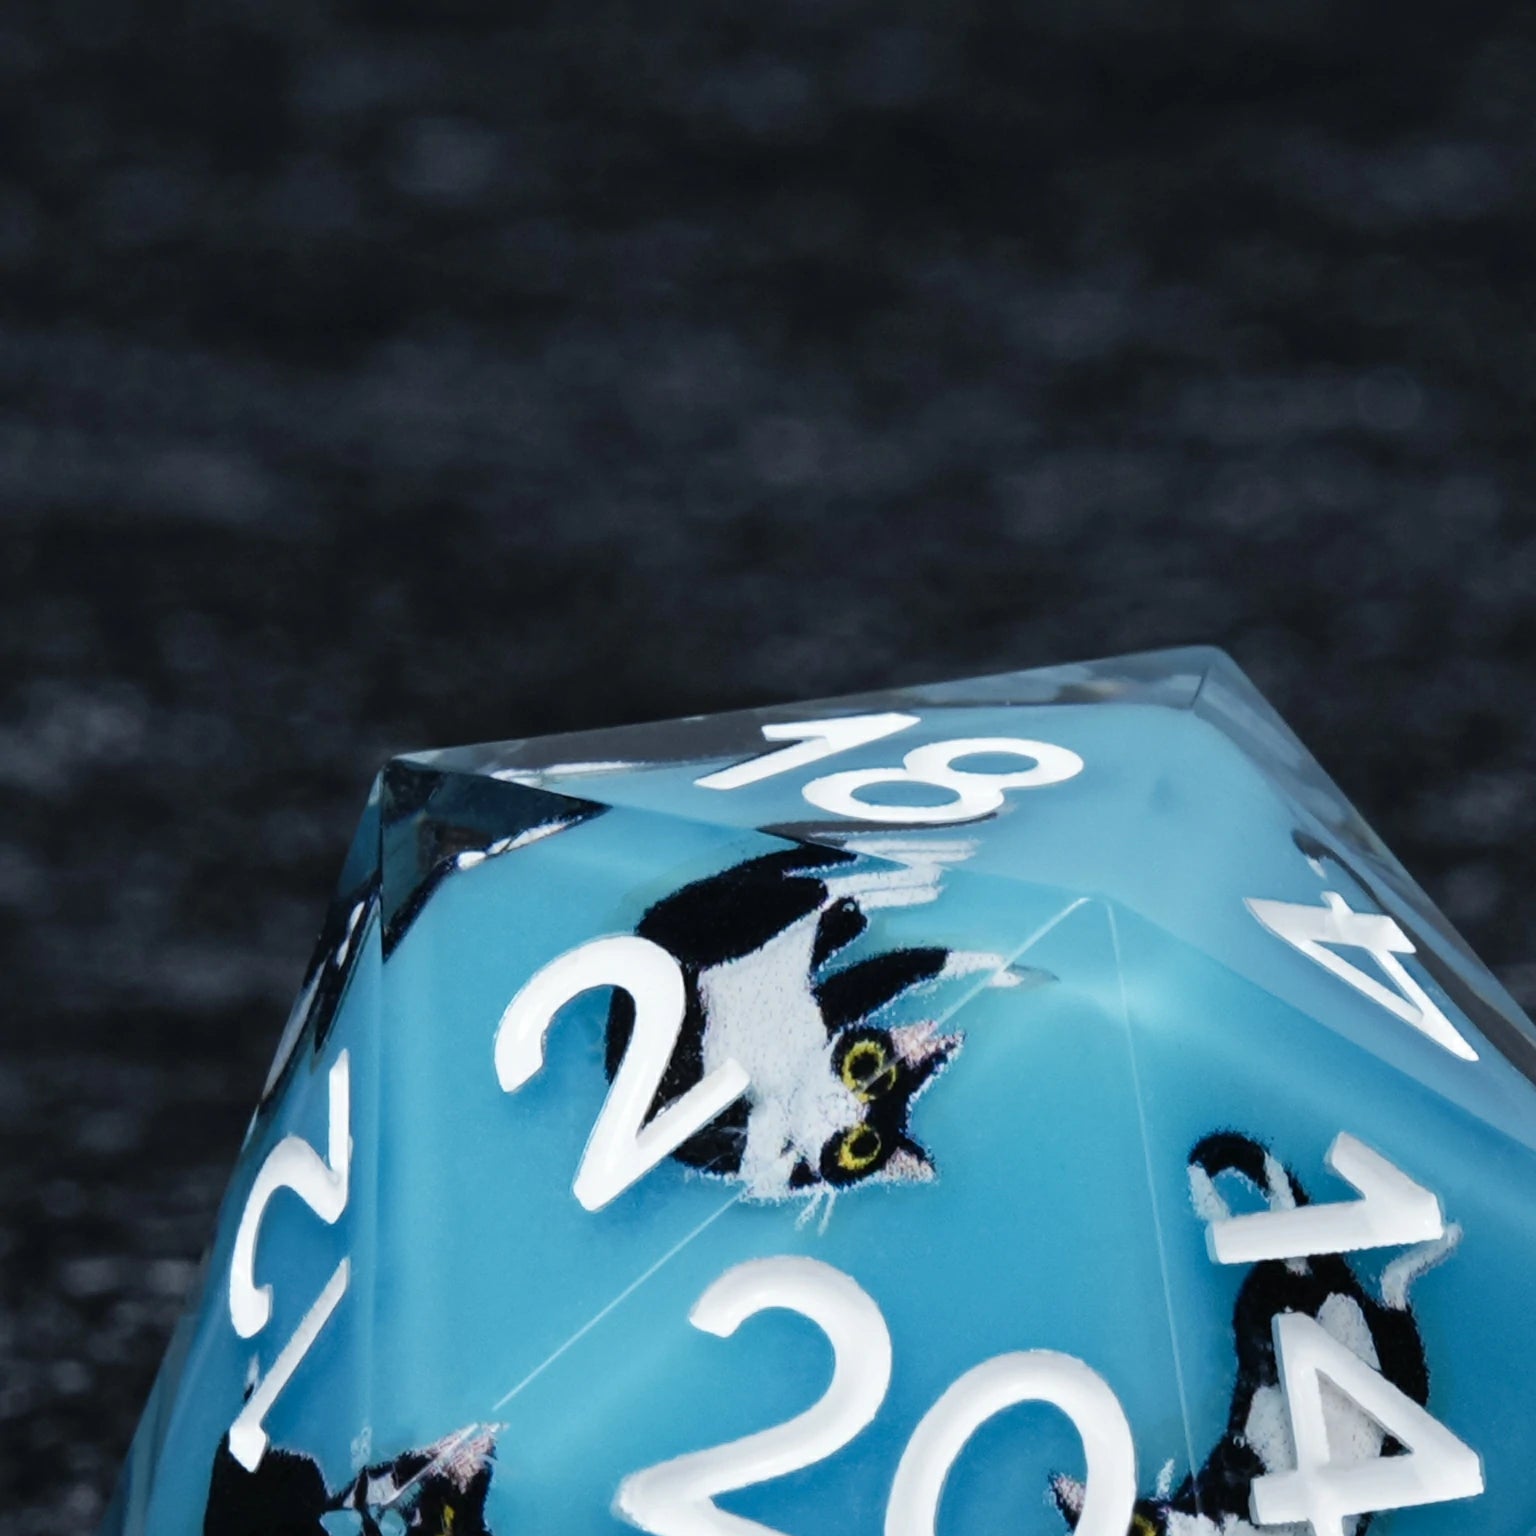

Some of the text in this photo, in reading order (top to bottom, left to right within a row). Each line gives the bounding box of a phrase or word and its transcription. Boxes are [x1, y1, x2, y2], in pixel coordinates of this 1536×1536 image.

[694, 712, 1085, 824] 18
[1243, 891, 1479, 1062] 4
[494, 934, 750, 1212] 2
